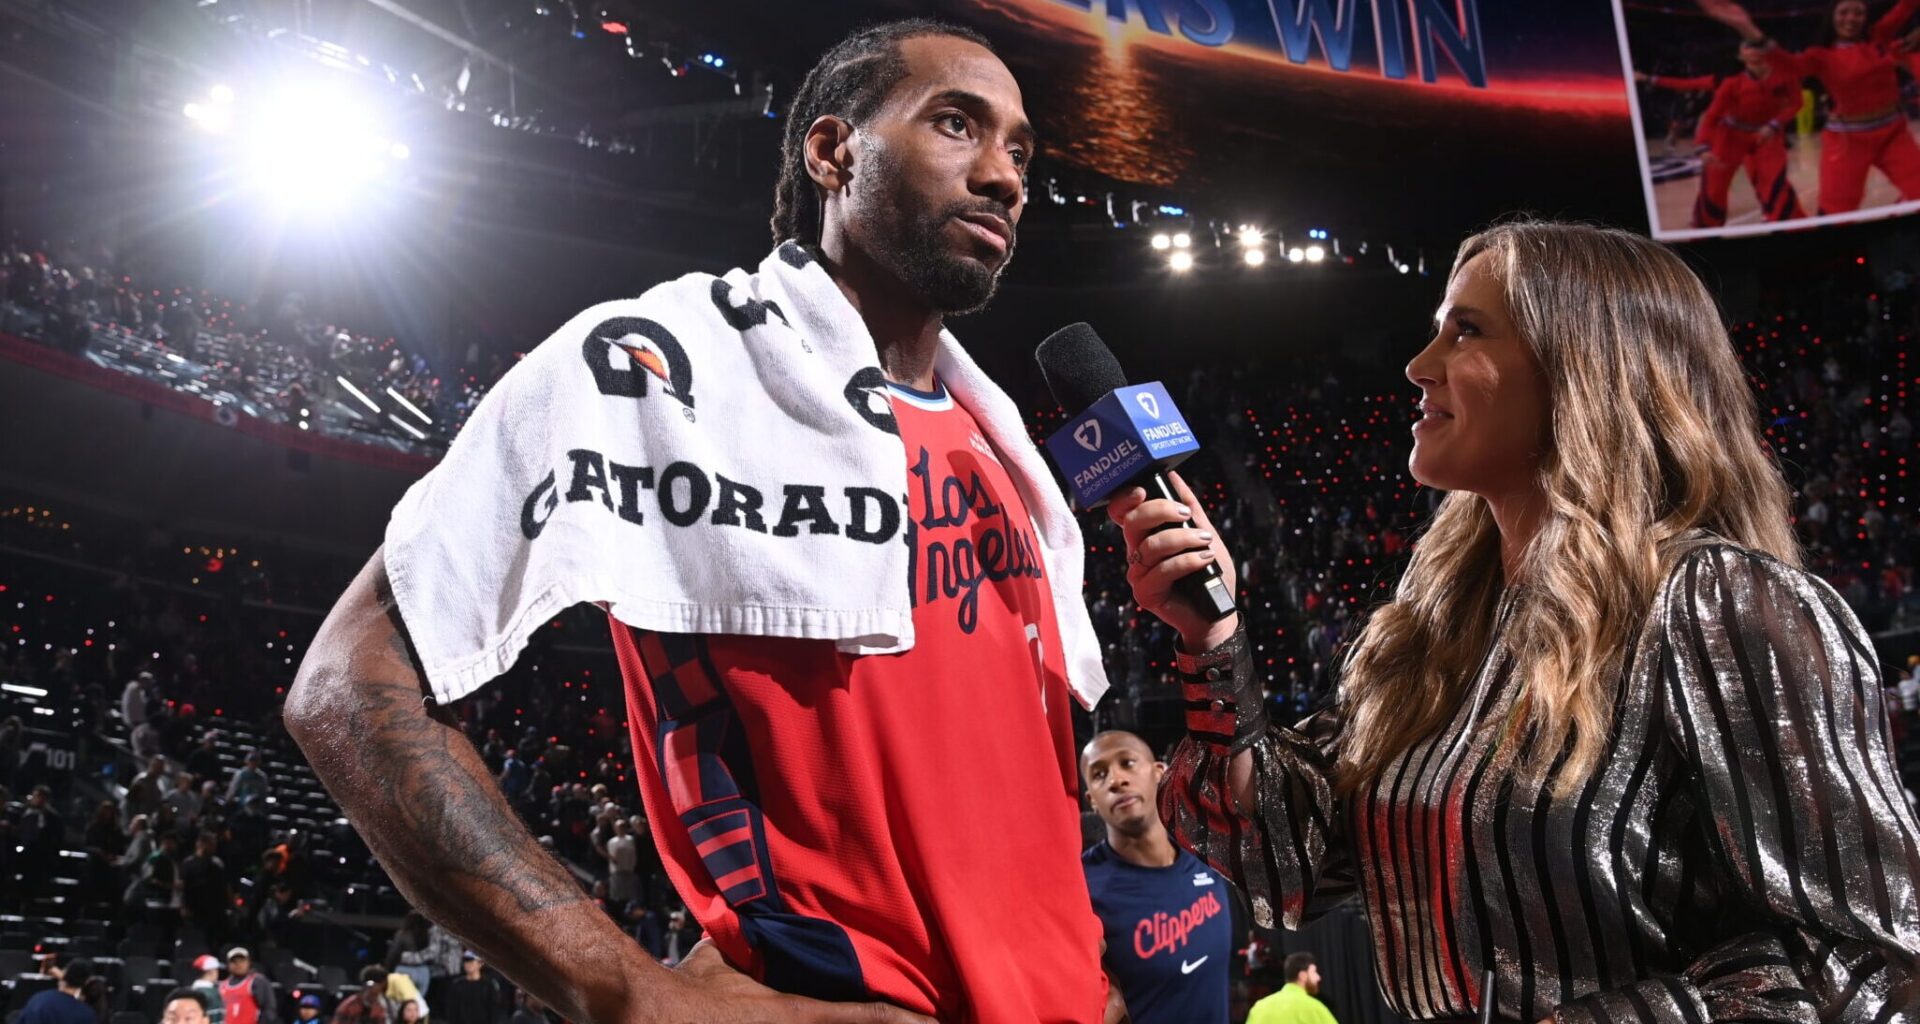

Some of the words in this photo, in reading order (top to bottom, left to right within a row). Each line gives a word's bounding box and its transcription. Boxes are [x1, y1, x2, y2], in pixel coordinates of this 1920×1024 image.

[1267, 0, 1487, 88] WIN
[1143, 422, 1187, 441] FANDUEL
[910, 445, 999, 531] Los
[1074, 439, 1138, 489] FANDUEL
[1082, 475, 1110, 498] SPORTS
[1108, 452, 1144, 480] NETWORK
[520, 448, 909, 546] GATORAD
[45, 748, 76, 771] 101
[1134, 891, 1221, 959] Clippers
